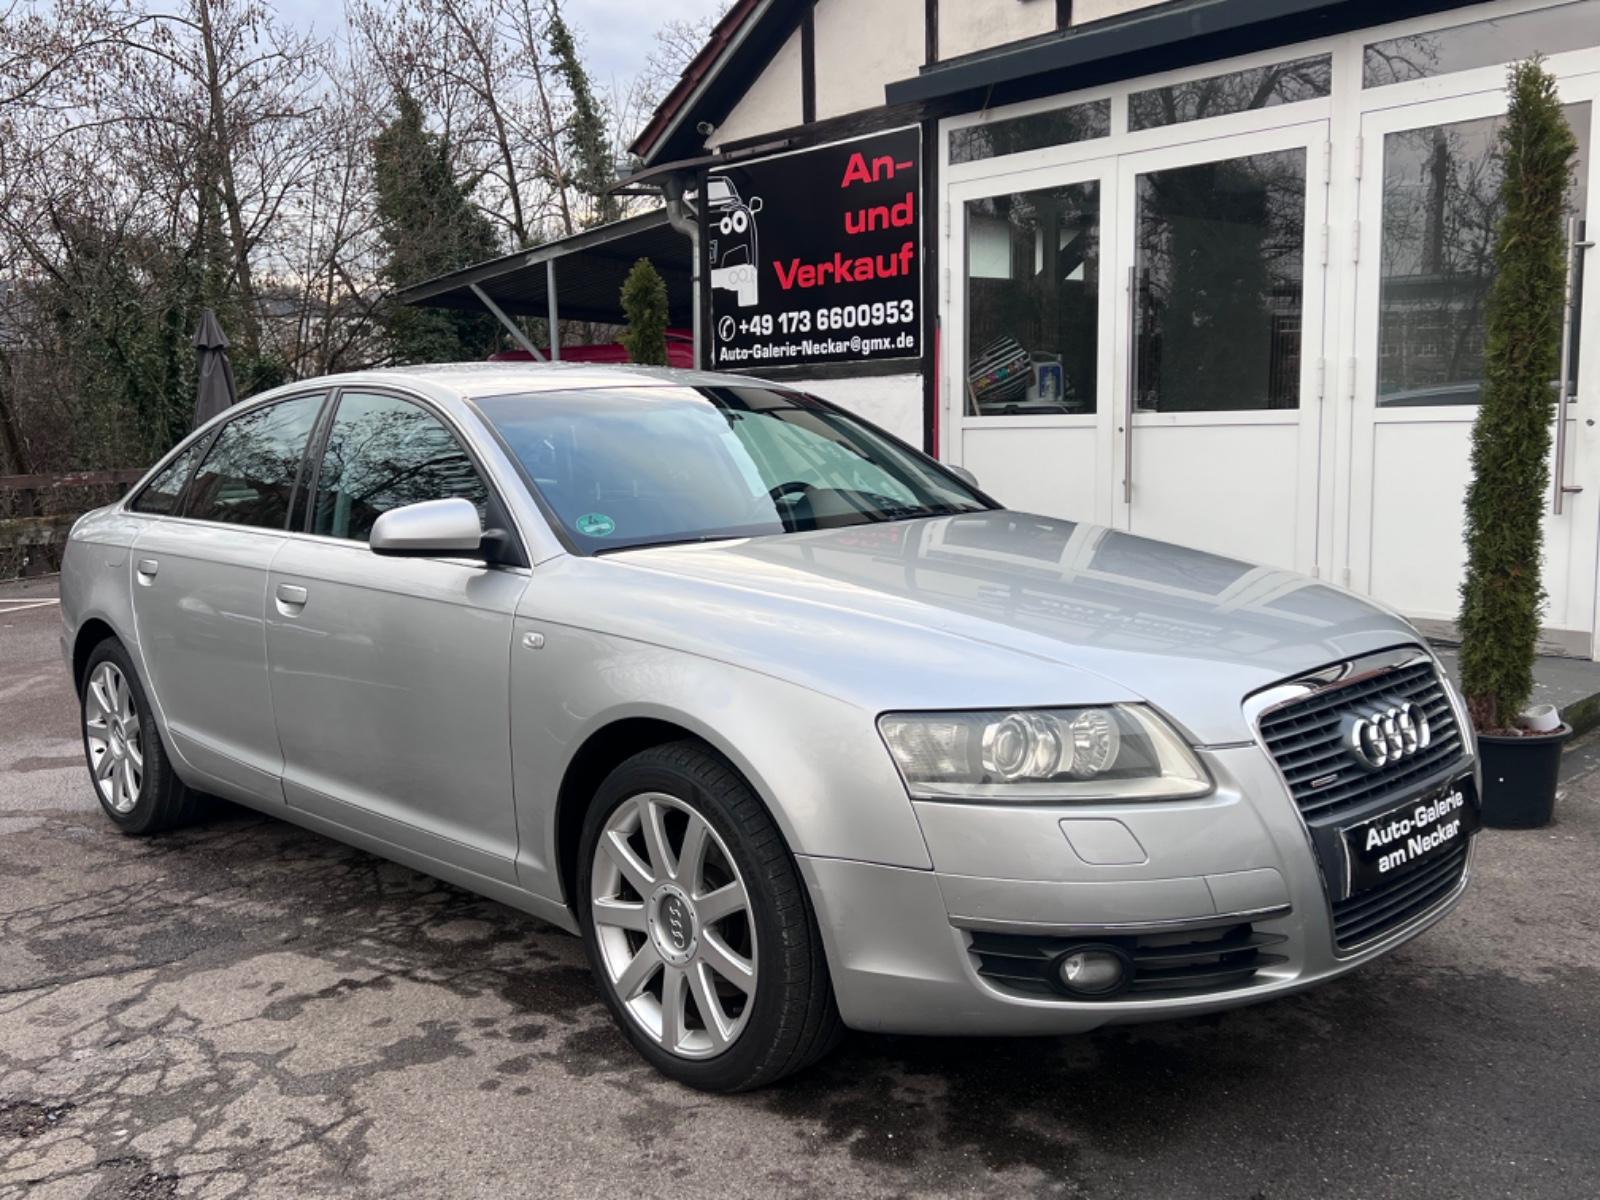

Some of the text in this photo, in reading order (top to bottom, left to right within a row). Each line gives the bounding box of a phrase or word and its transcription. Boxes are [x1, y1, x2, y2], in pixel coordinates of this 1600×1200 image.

[841, 152, 913, 188] An-
[844, 192, 913, 234] und
[773, 241, 913, 290] Verkauf
[739, 299, 914, 336] +49 173 6600953
[720, 332, 914, 361] Auto-Galerie-Neckar@gmx.de
[1365, 789, 1464, 851] Auto-Galerie
[1378, 819, 1461, 873] am Neckar
